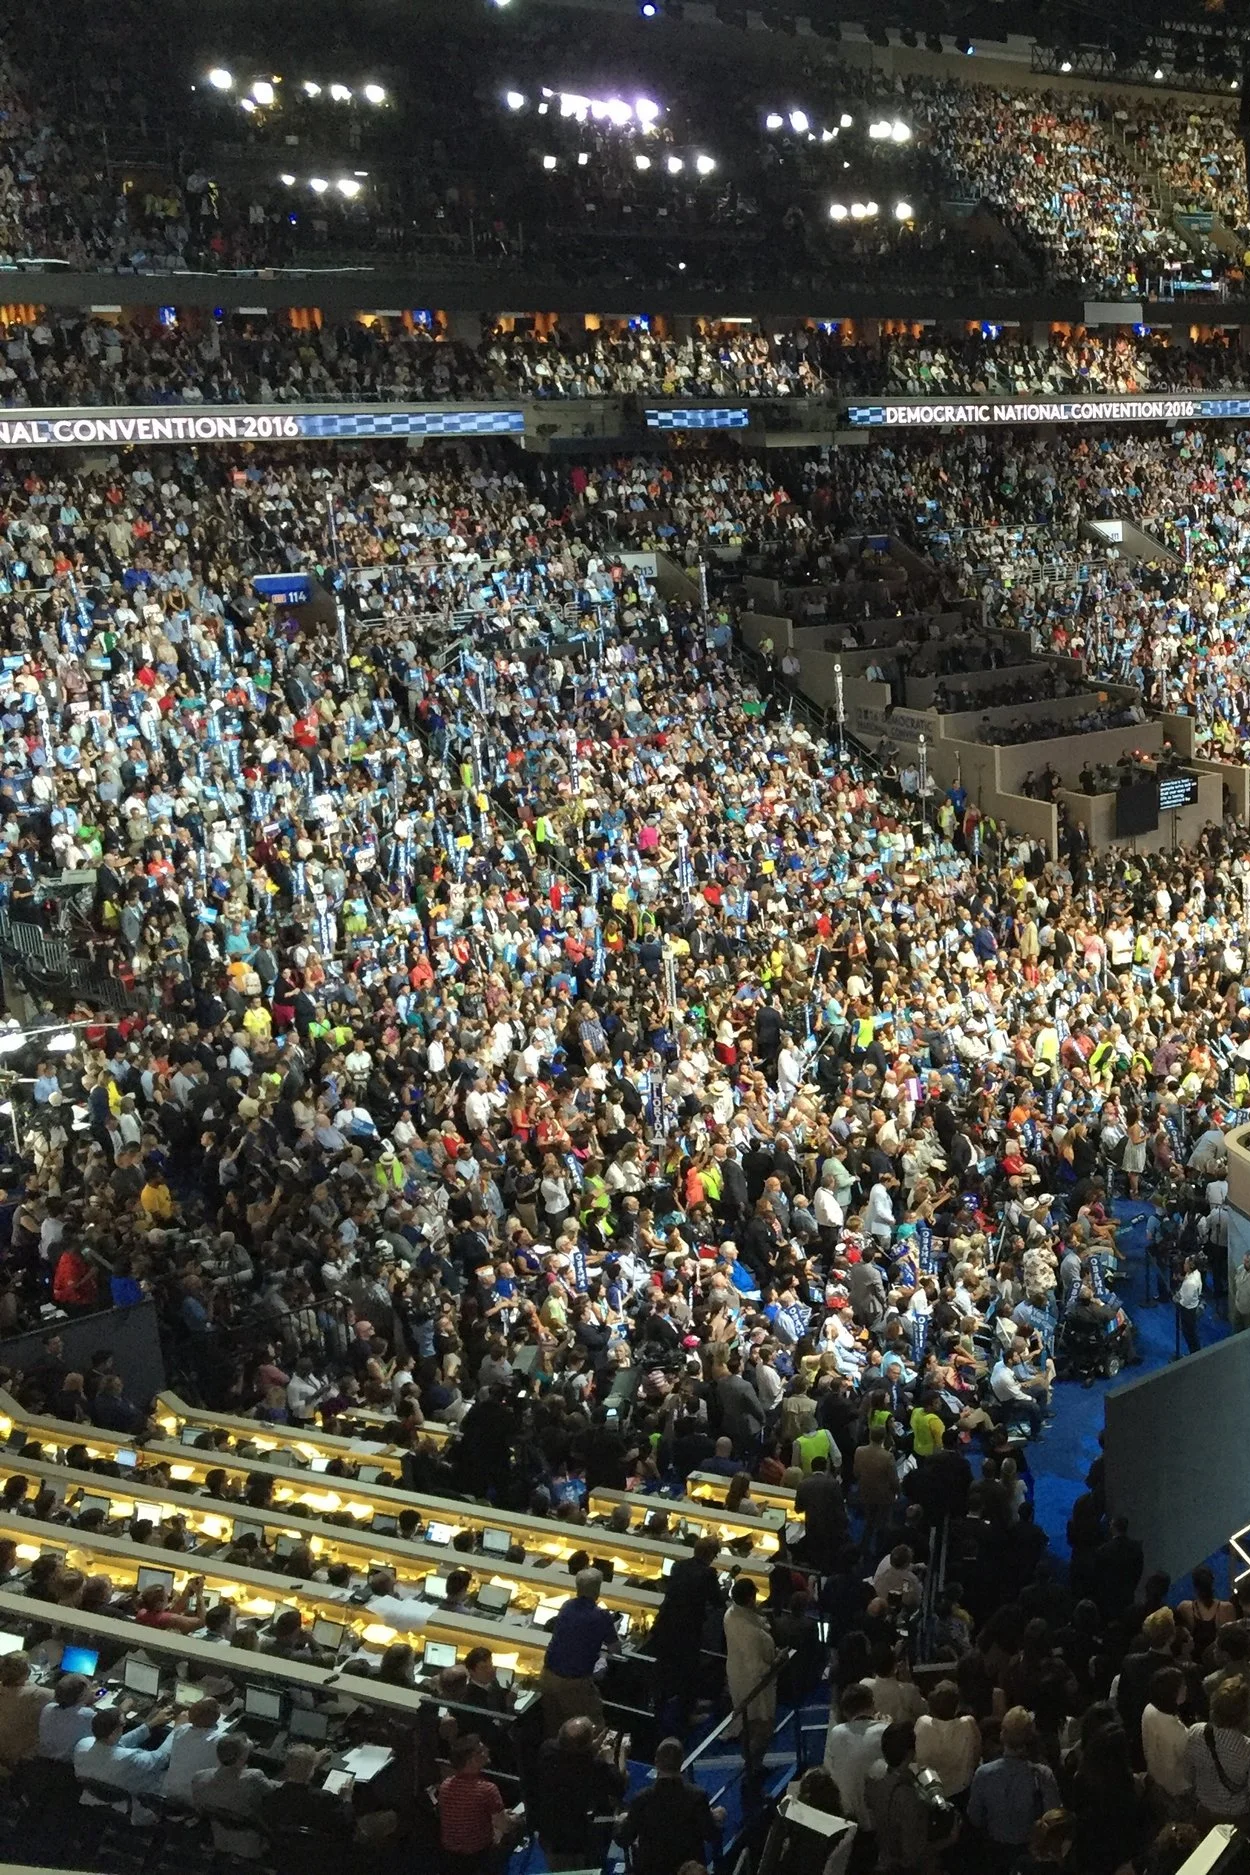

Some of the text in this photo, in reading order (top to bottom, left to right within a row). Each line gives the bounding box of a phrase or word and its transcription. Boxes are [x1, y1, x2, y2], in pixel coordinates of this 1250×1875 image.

[886, 401, 1194, 424] DEMOCRATIC NATIONAL CONVENTION 2016
[53, 416, 237, 442] CONVENTION
[243, 416, 299, 438] 2016
[288, 591, 307, 603] 114
[882, 713, 933, 733] DMOCRATIC
[652, 1083, 662, 1139] FLORIDA
[1046, 1092, 1054, 1122] OBAMA
[921, 1229, 931, 1265] OBAMA
[574, 1253, 587, 1287] OBAMA
[1090, 1258, 1104, 1295] OBAMA
